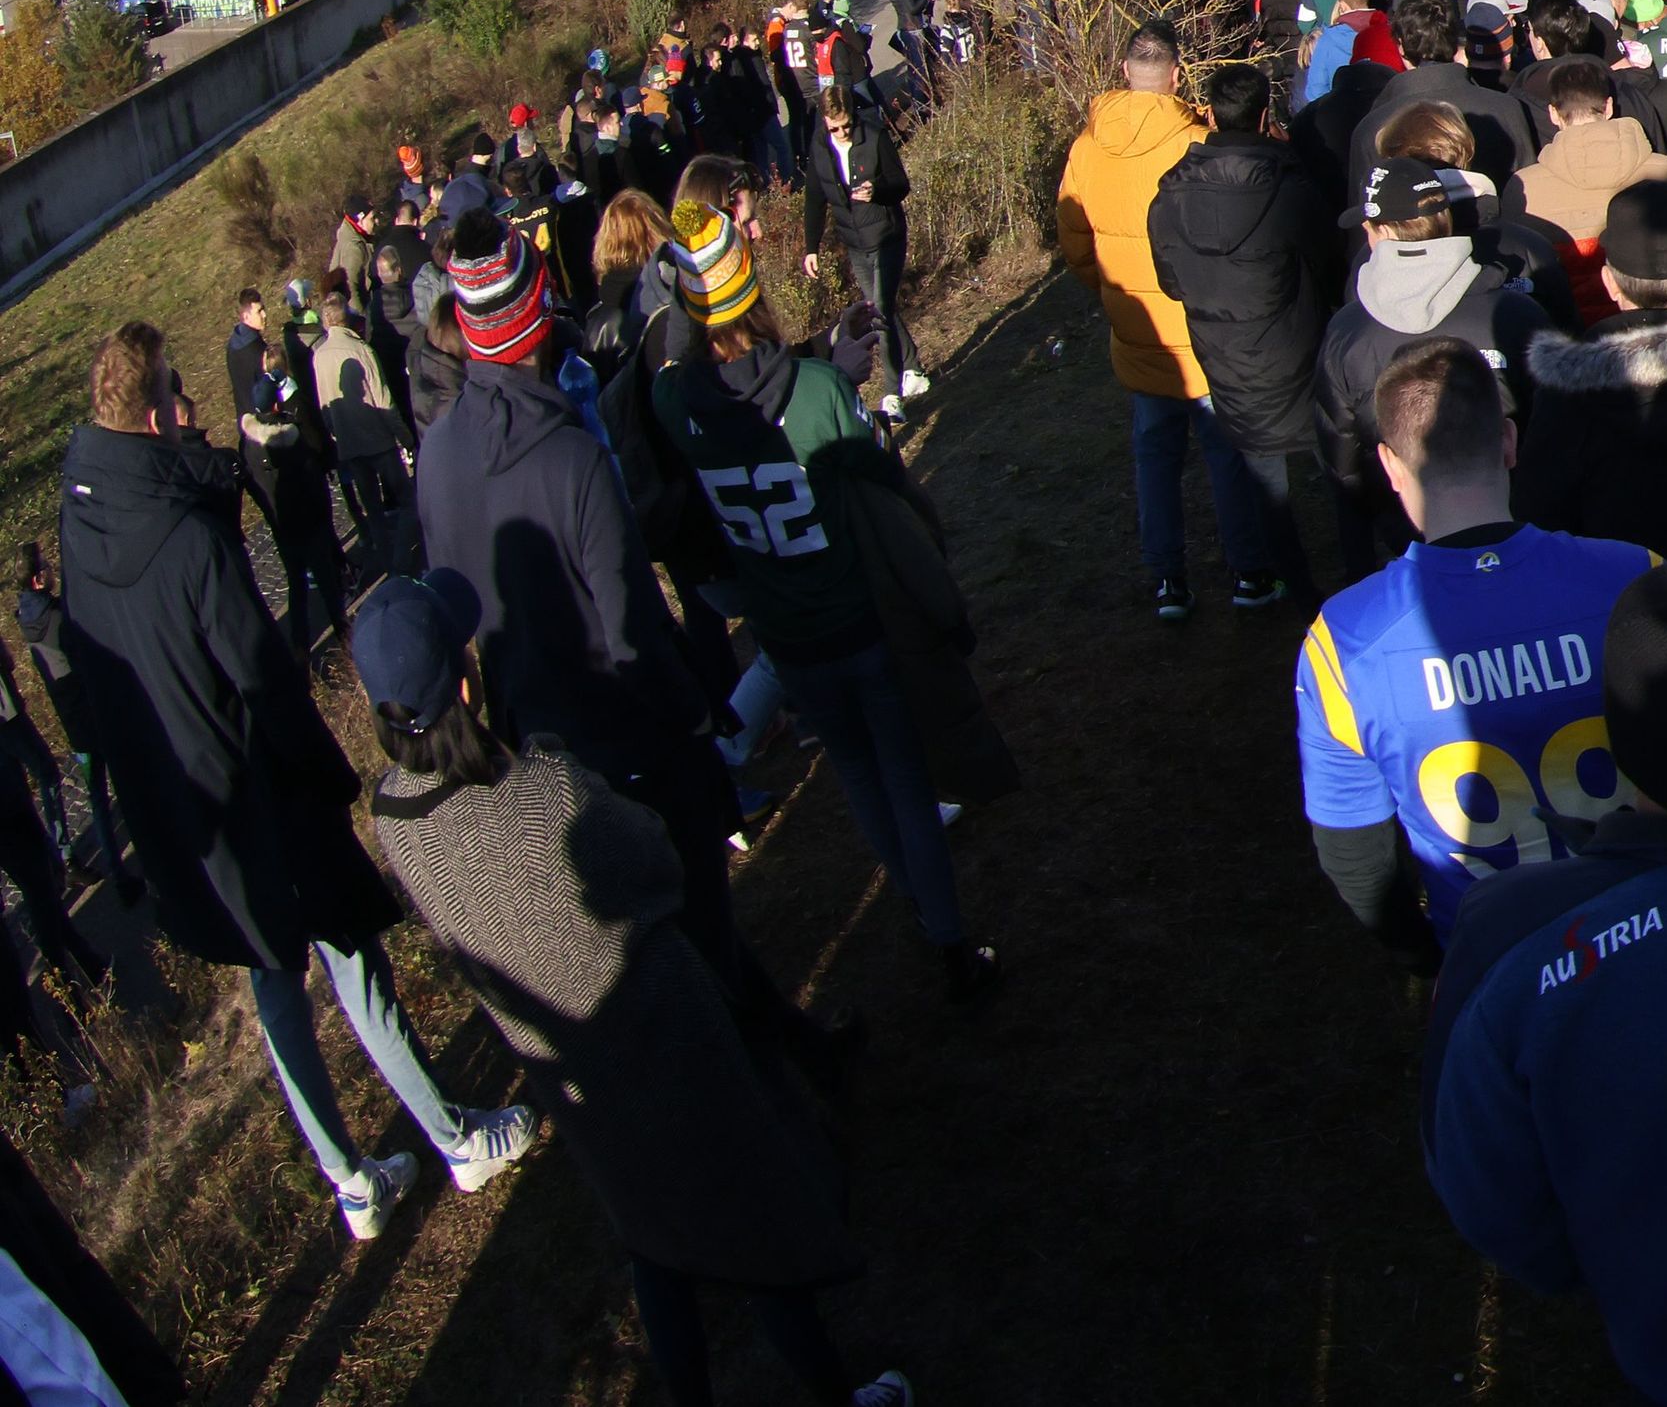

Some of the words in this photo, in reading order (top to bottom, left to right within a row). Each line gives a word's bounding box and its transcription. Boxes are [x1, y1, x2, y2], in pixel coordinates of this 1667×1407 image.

[786, 41, 807, 69] 12
[697, 462, 829, 557] 52
[1422, 634, 1592, 711] DONALD
